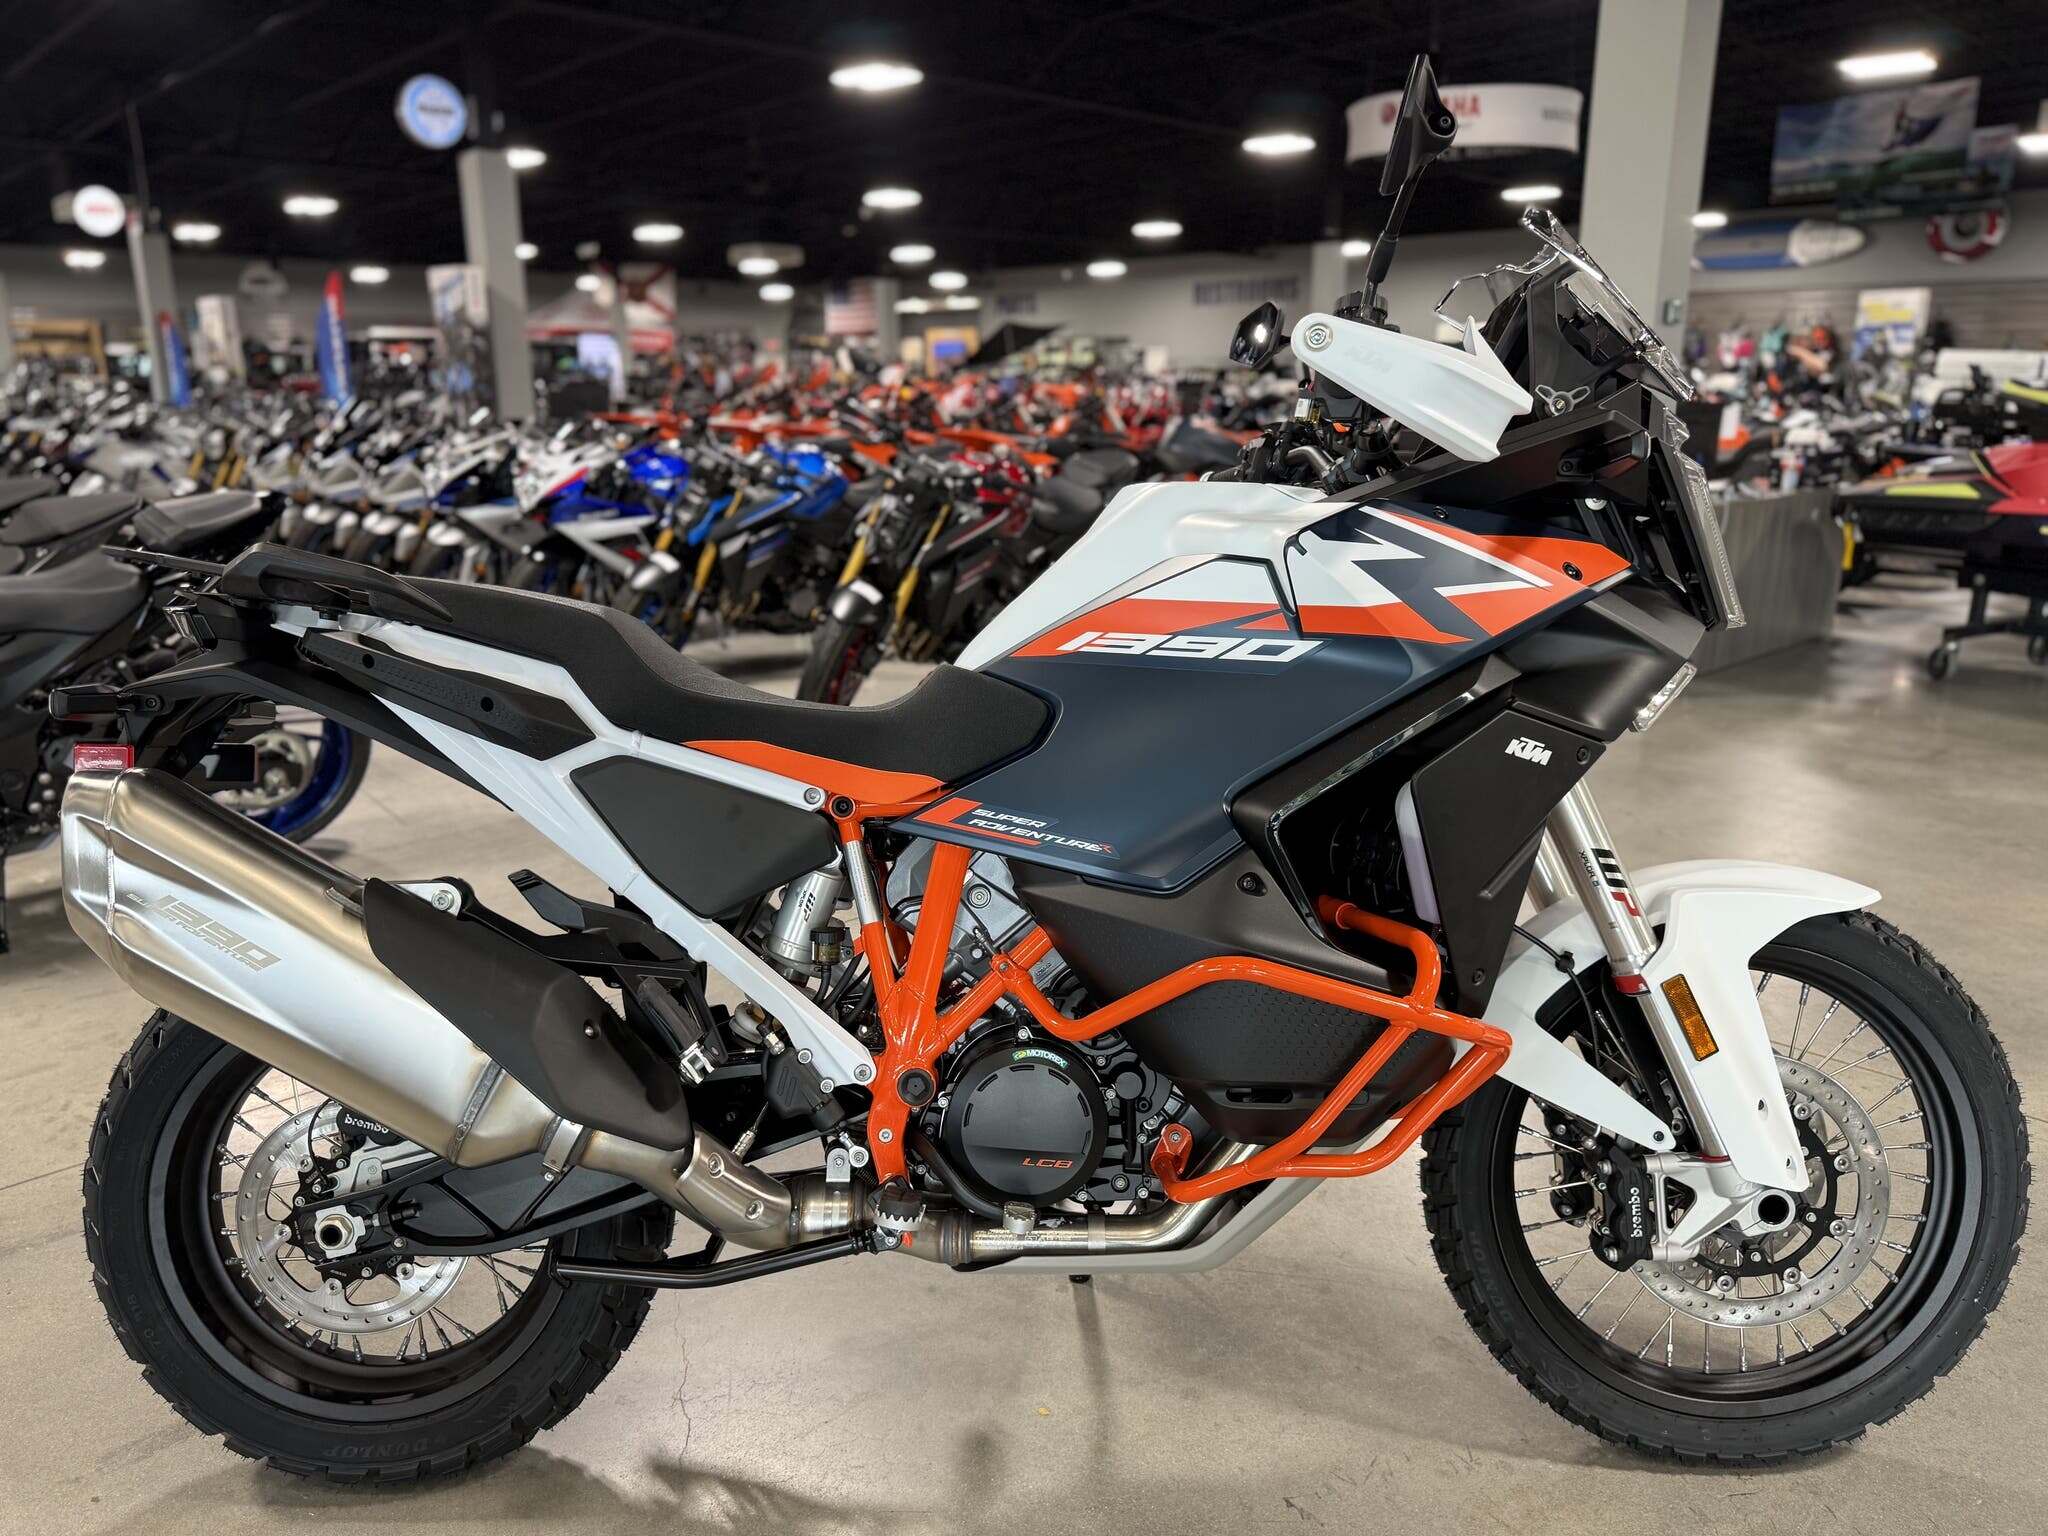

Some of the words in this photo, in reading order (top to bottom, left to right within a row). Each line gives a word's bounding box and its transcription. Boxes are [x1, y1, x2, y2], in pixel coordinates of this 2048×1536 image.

[1055, 631, 1325, 663] 1390
[1504, 736, 1553, 766] KTM
[971, 808, 1048, 829] SUPER
[155, 894, 283, 970] 1390
[1026, 1049, 1067, 1068] MOTOREX
[344, 1113, 390, 1134] brembo
[1022, 1157, 1073, 1169] LC8
[1628, 1186, 1643, 1238] brembo
